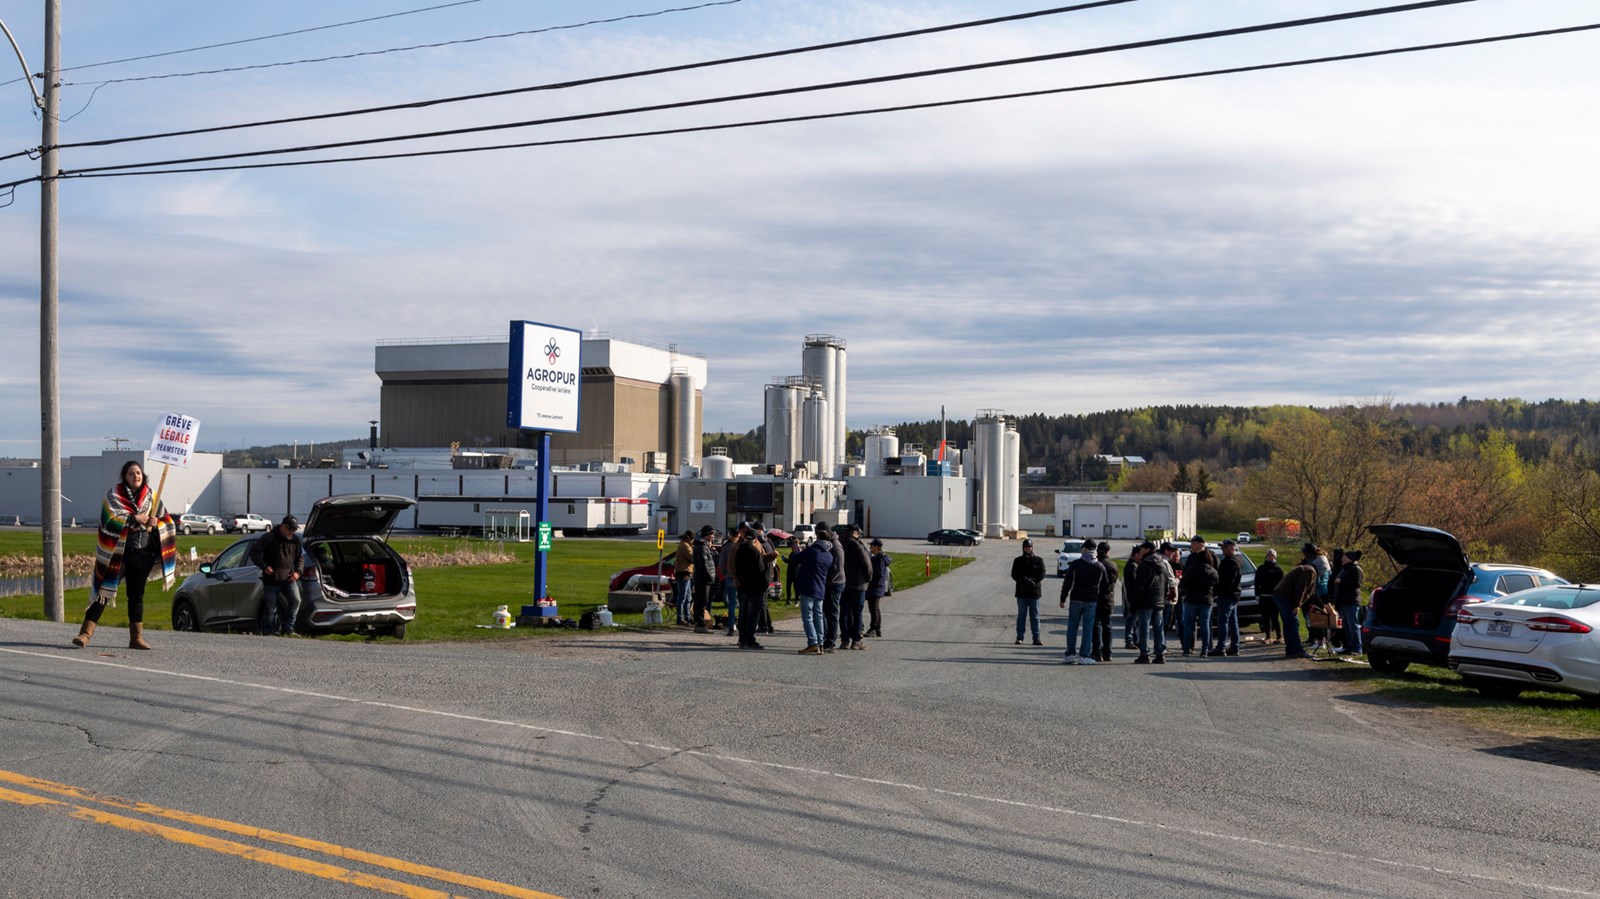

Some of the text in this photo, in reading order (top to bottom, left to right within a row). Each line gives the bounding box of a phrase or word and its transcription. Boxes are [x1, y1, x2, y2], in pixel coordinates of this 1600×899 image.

[527, 368, 576, 385] AGROPUR
[531, 383, 557, 393] Coopérative
[166, 414, 192, 430] GRÈVE
[160, 427, 190, 444] LÉGALE
[157, 443, 187, 456] TEAMSTERS
